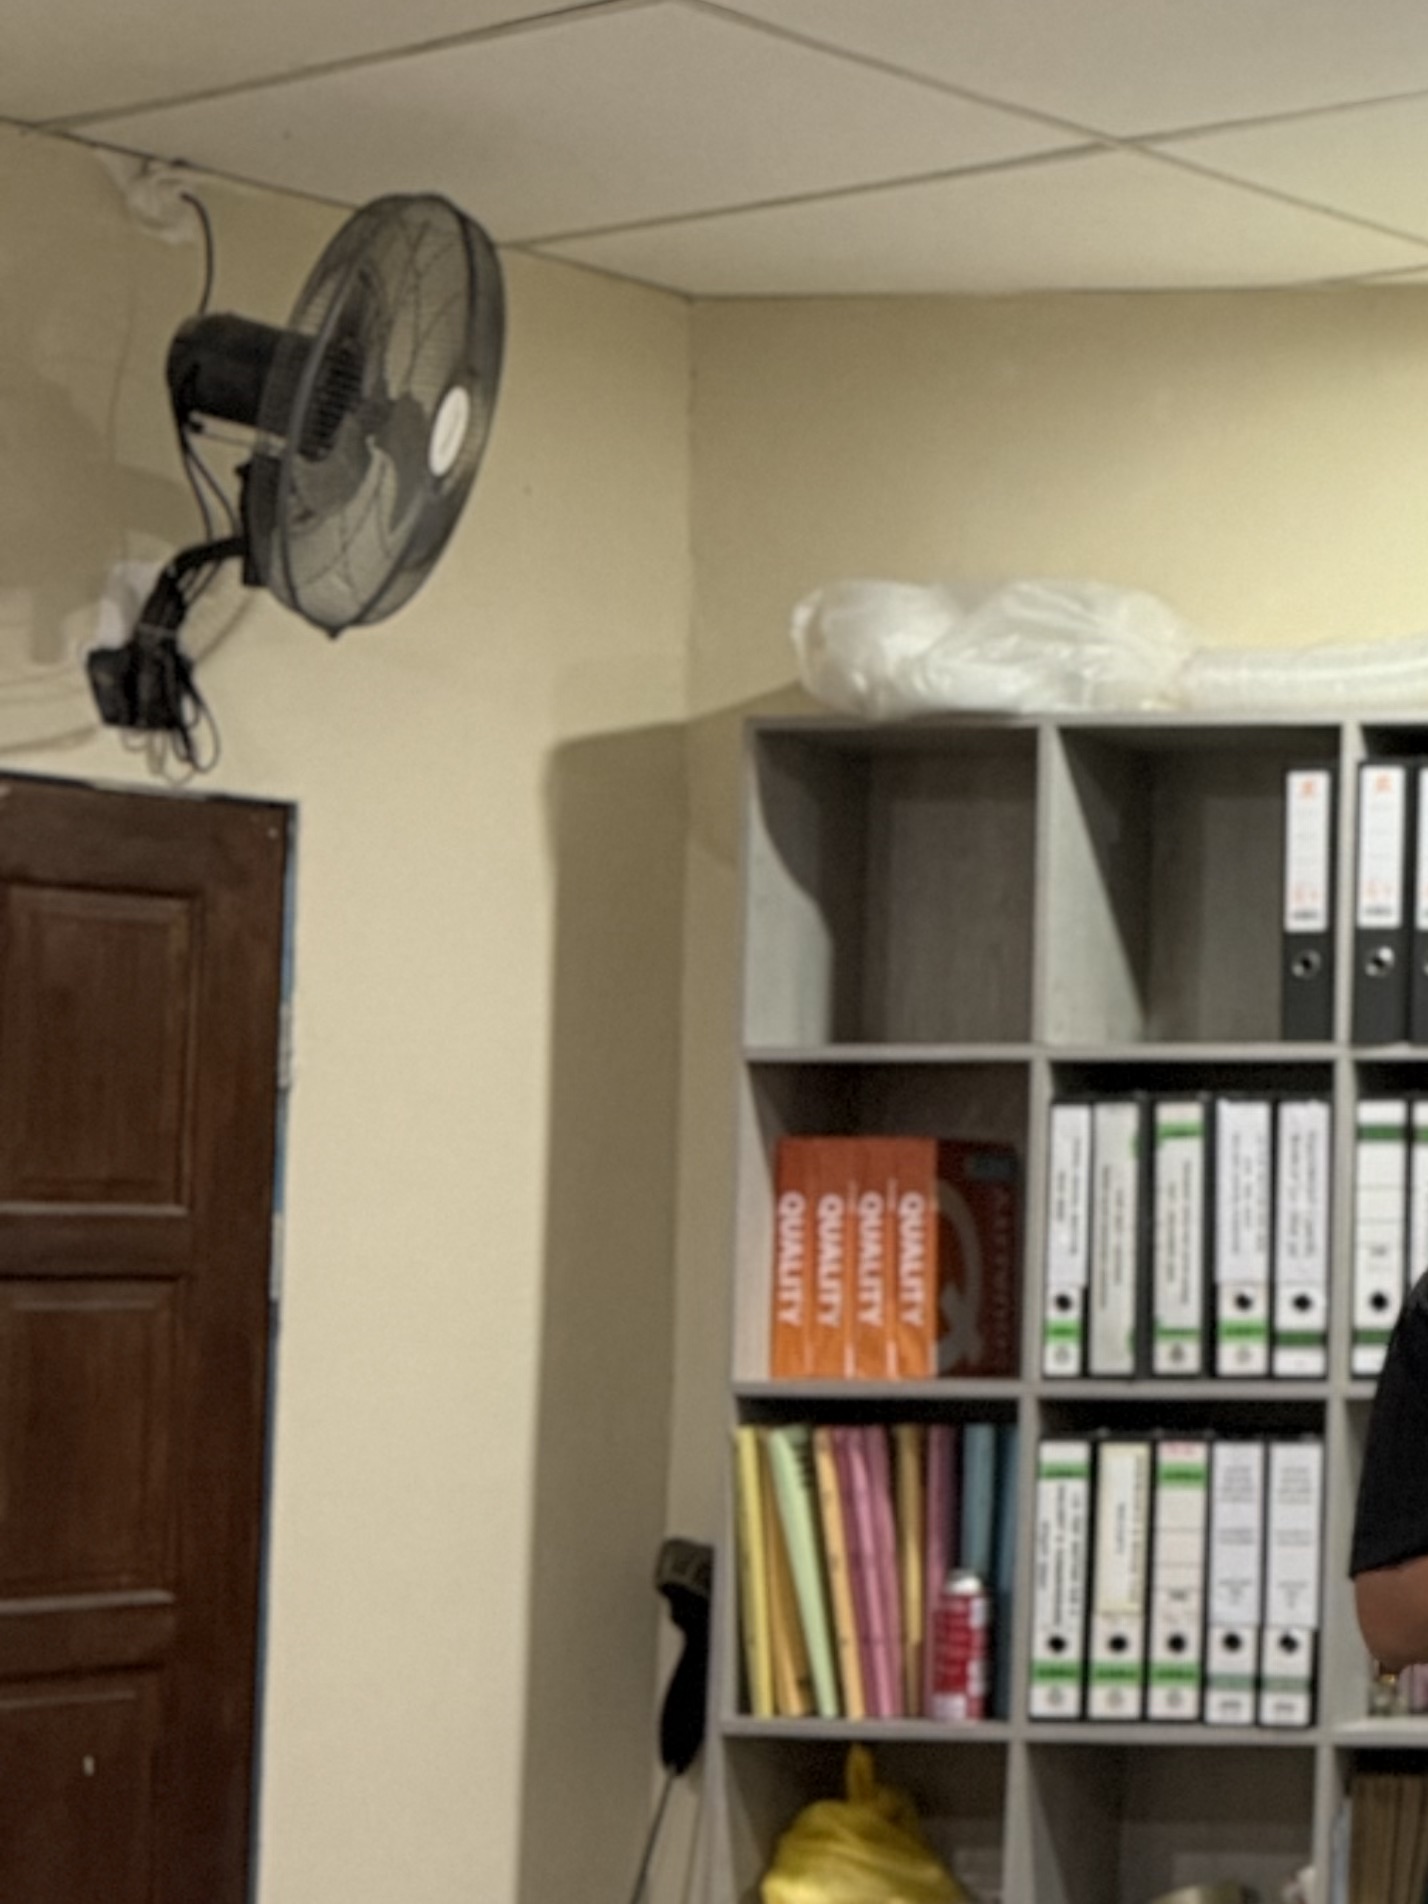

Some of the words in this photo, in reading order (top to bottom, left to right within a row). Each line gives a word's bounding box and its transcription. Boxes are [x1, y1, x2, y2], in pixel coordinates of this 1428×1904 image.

[778, 1191, 806, 1327] QUALITY
[815, 1193, 844, 1328] QUALITY
[857, 1190, 884, 1327] QUALITY
[899, 1190, 926, 1327] QUALITY
